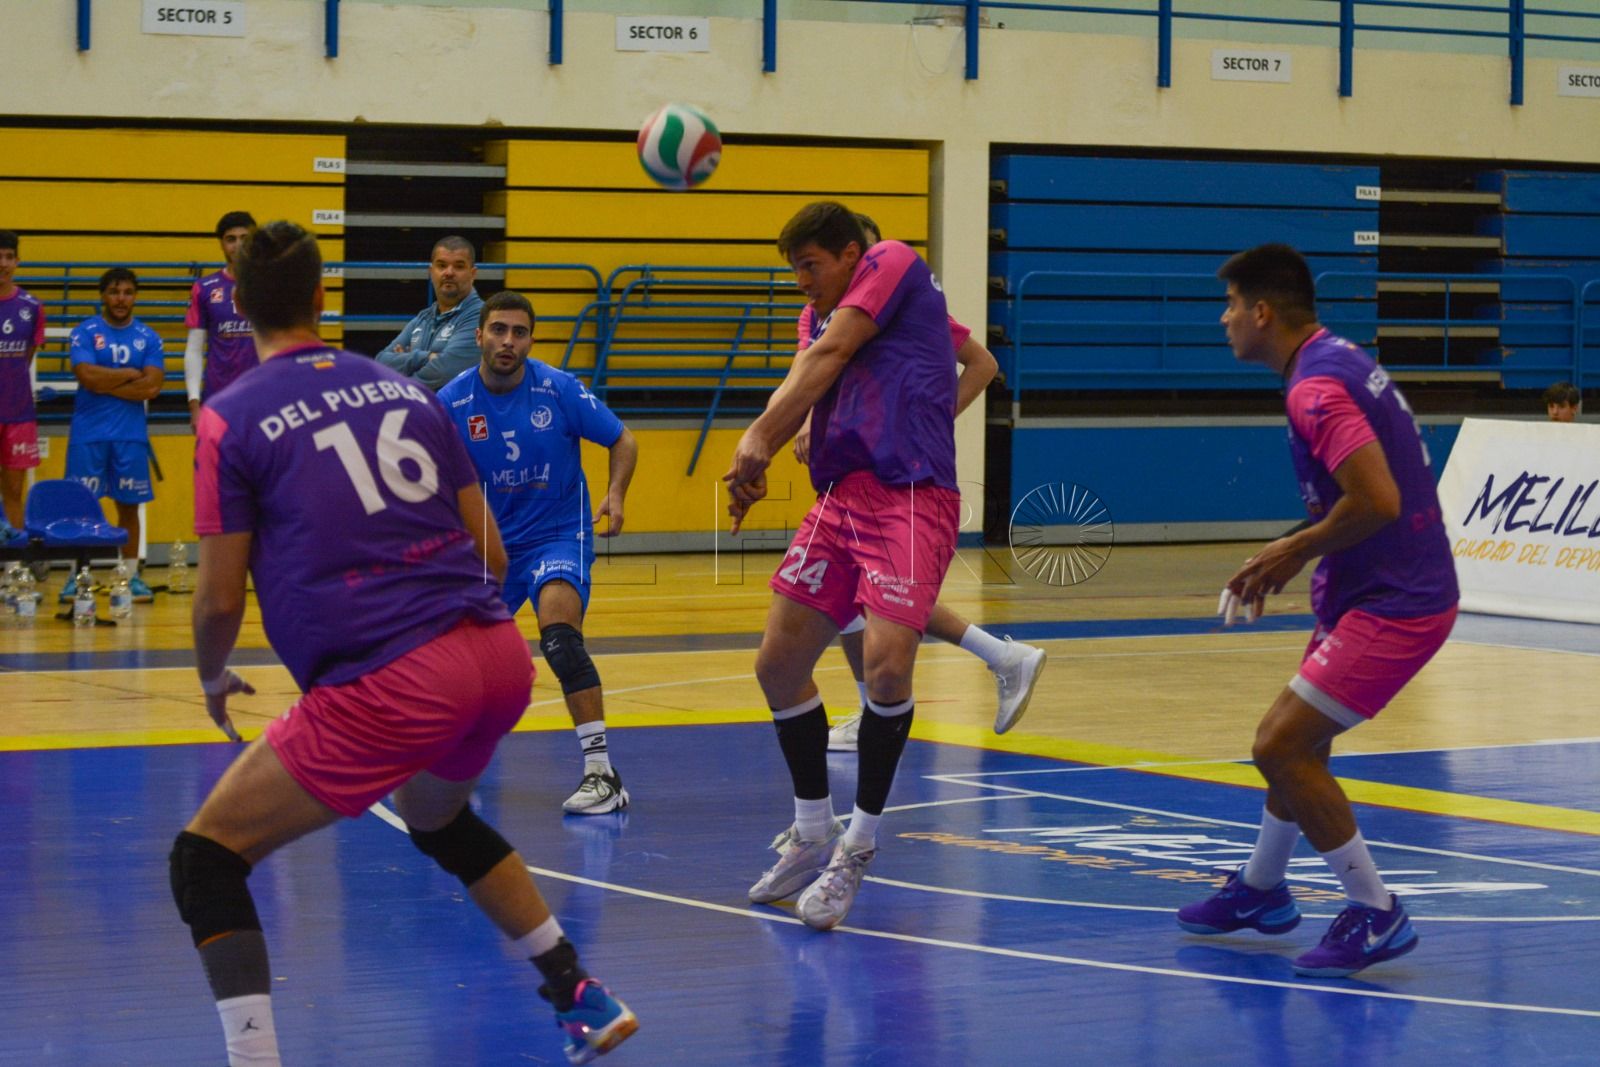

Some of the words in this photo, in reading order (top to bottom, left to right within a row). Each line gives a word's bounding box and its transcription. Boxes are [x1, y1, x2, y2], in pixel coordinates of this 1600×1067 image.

[157, 7, 217, 23] SECTOR
[223, 11, 233, 24] 5
[629, 25, 683, 40] SECTOR
[688, 27, 698, 40] 6
[1223, 57, 1270, 71] SECTOR
[1274, 59, 1282, 72] 7
[316, 160, 334, 169] FILA
[1358, 188, 1372, 196] FILA
[315, 212, 333, 221] FILA
[1356, 234, 1370, 242] FILA
[2, 318, 14, 335] 6
[109, 343, 131, 364] 10
[258, 400, 323, 442] DEL
[501, 430, 521, 463] 5
[312, 408, 439, 516] 16
[492, 462, 550, 487] MELILLA
[1453, 537, 1516, 561] CIUDAD
[1516, 543, 1551, 566] DEL
[1554, 546, 1600, 571] DEPO
[778, 545, 829, 595] 24
